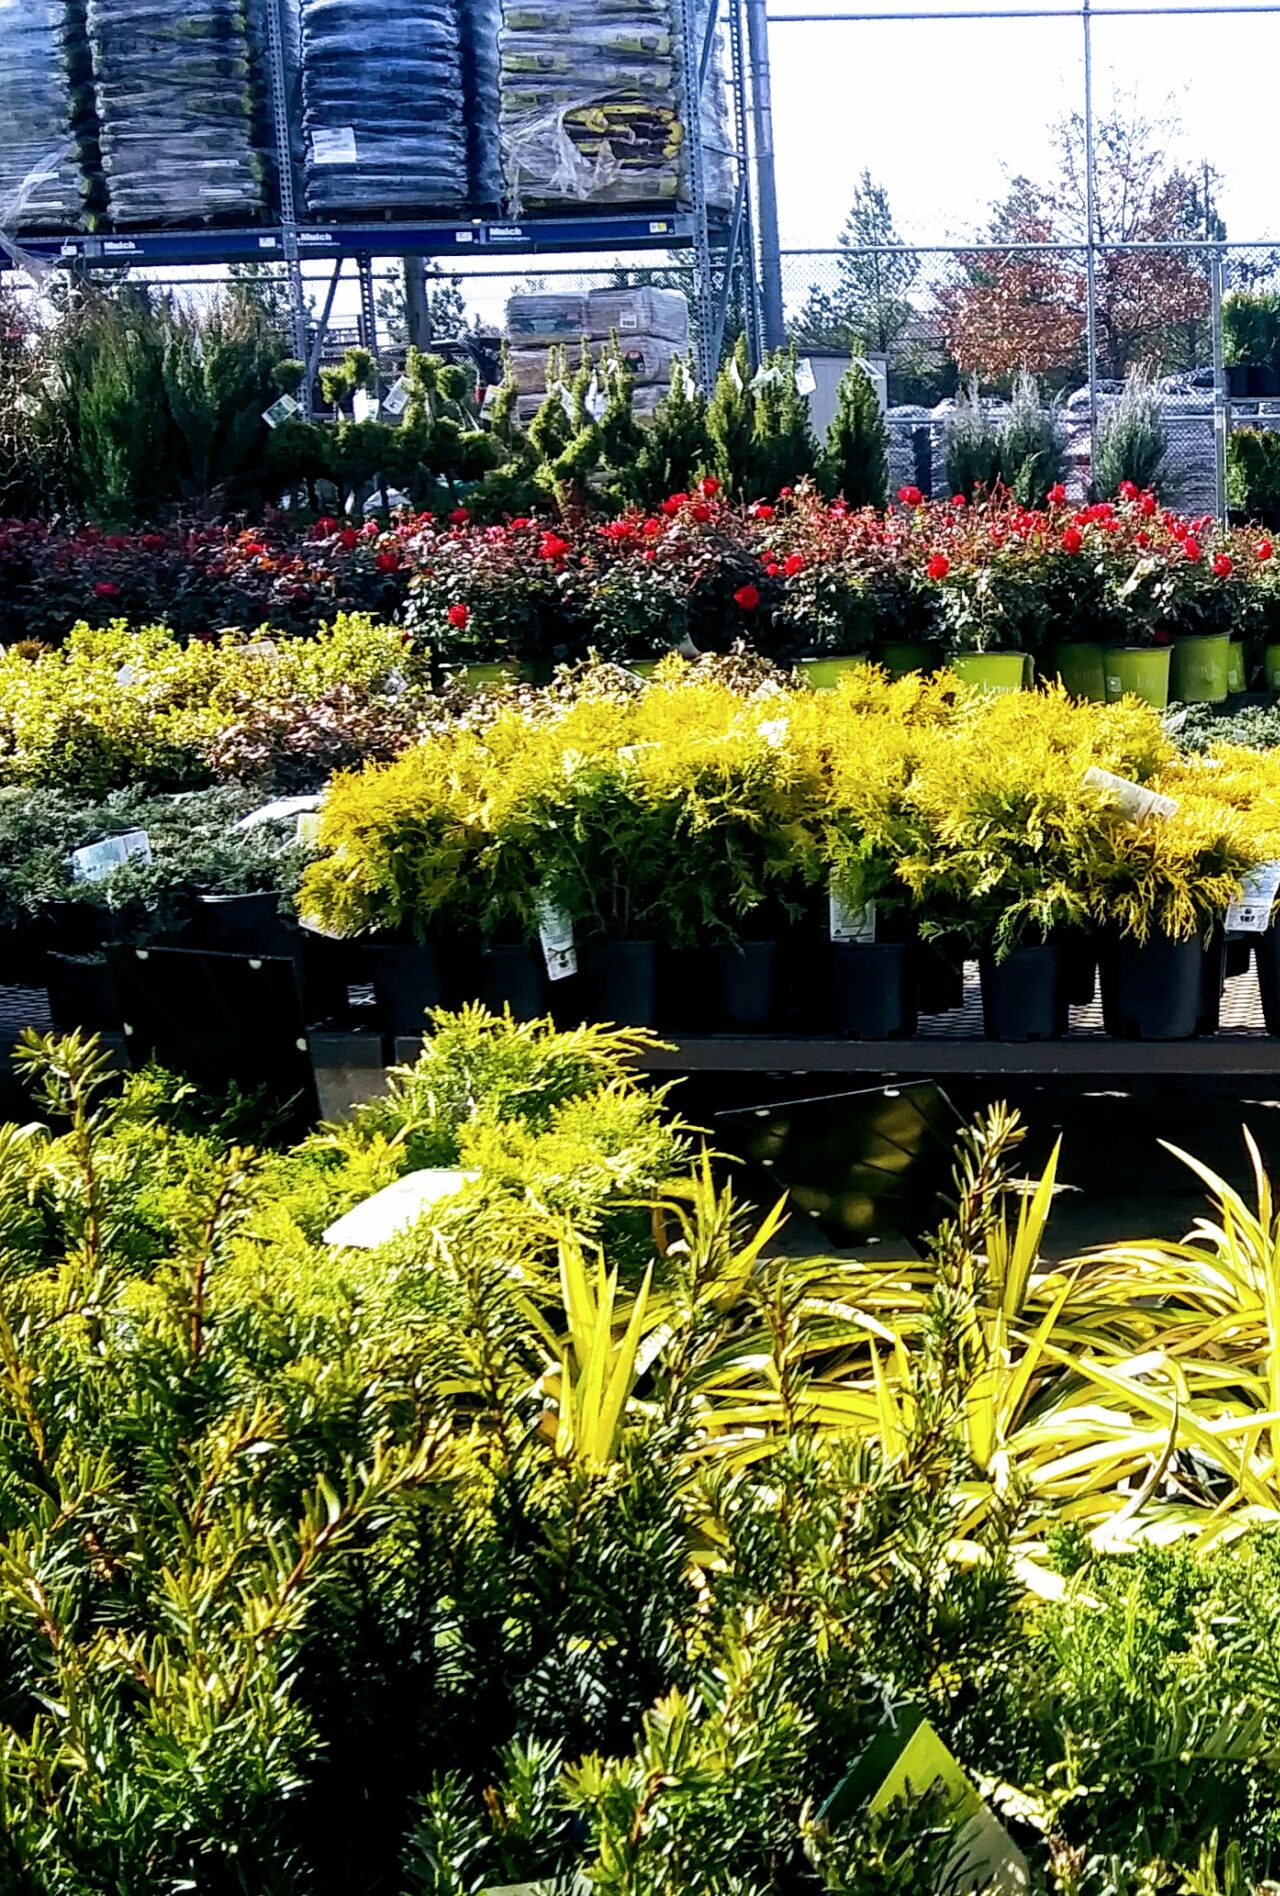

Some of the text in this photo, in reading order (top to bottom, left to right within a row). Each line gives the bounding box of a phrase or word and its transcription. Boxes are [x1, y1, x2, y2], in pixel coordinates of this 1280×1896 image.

[489, 227, 522, 236] Mulch
[300, 232, 332, 241] Mulch
[103, 241, 136, 250] Mulch
